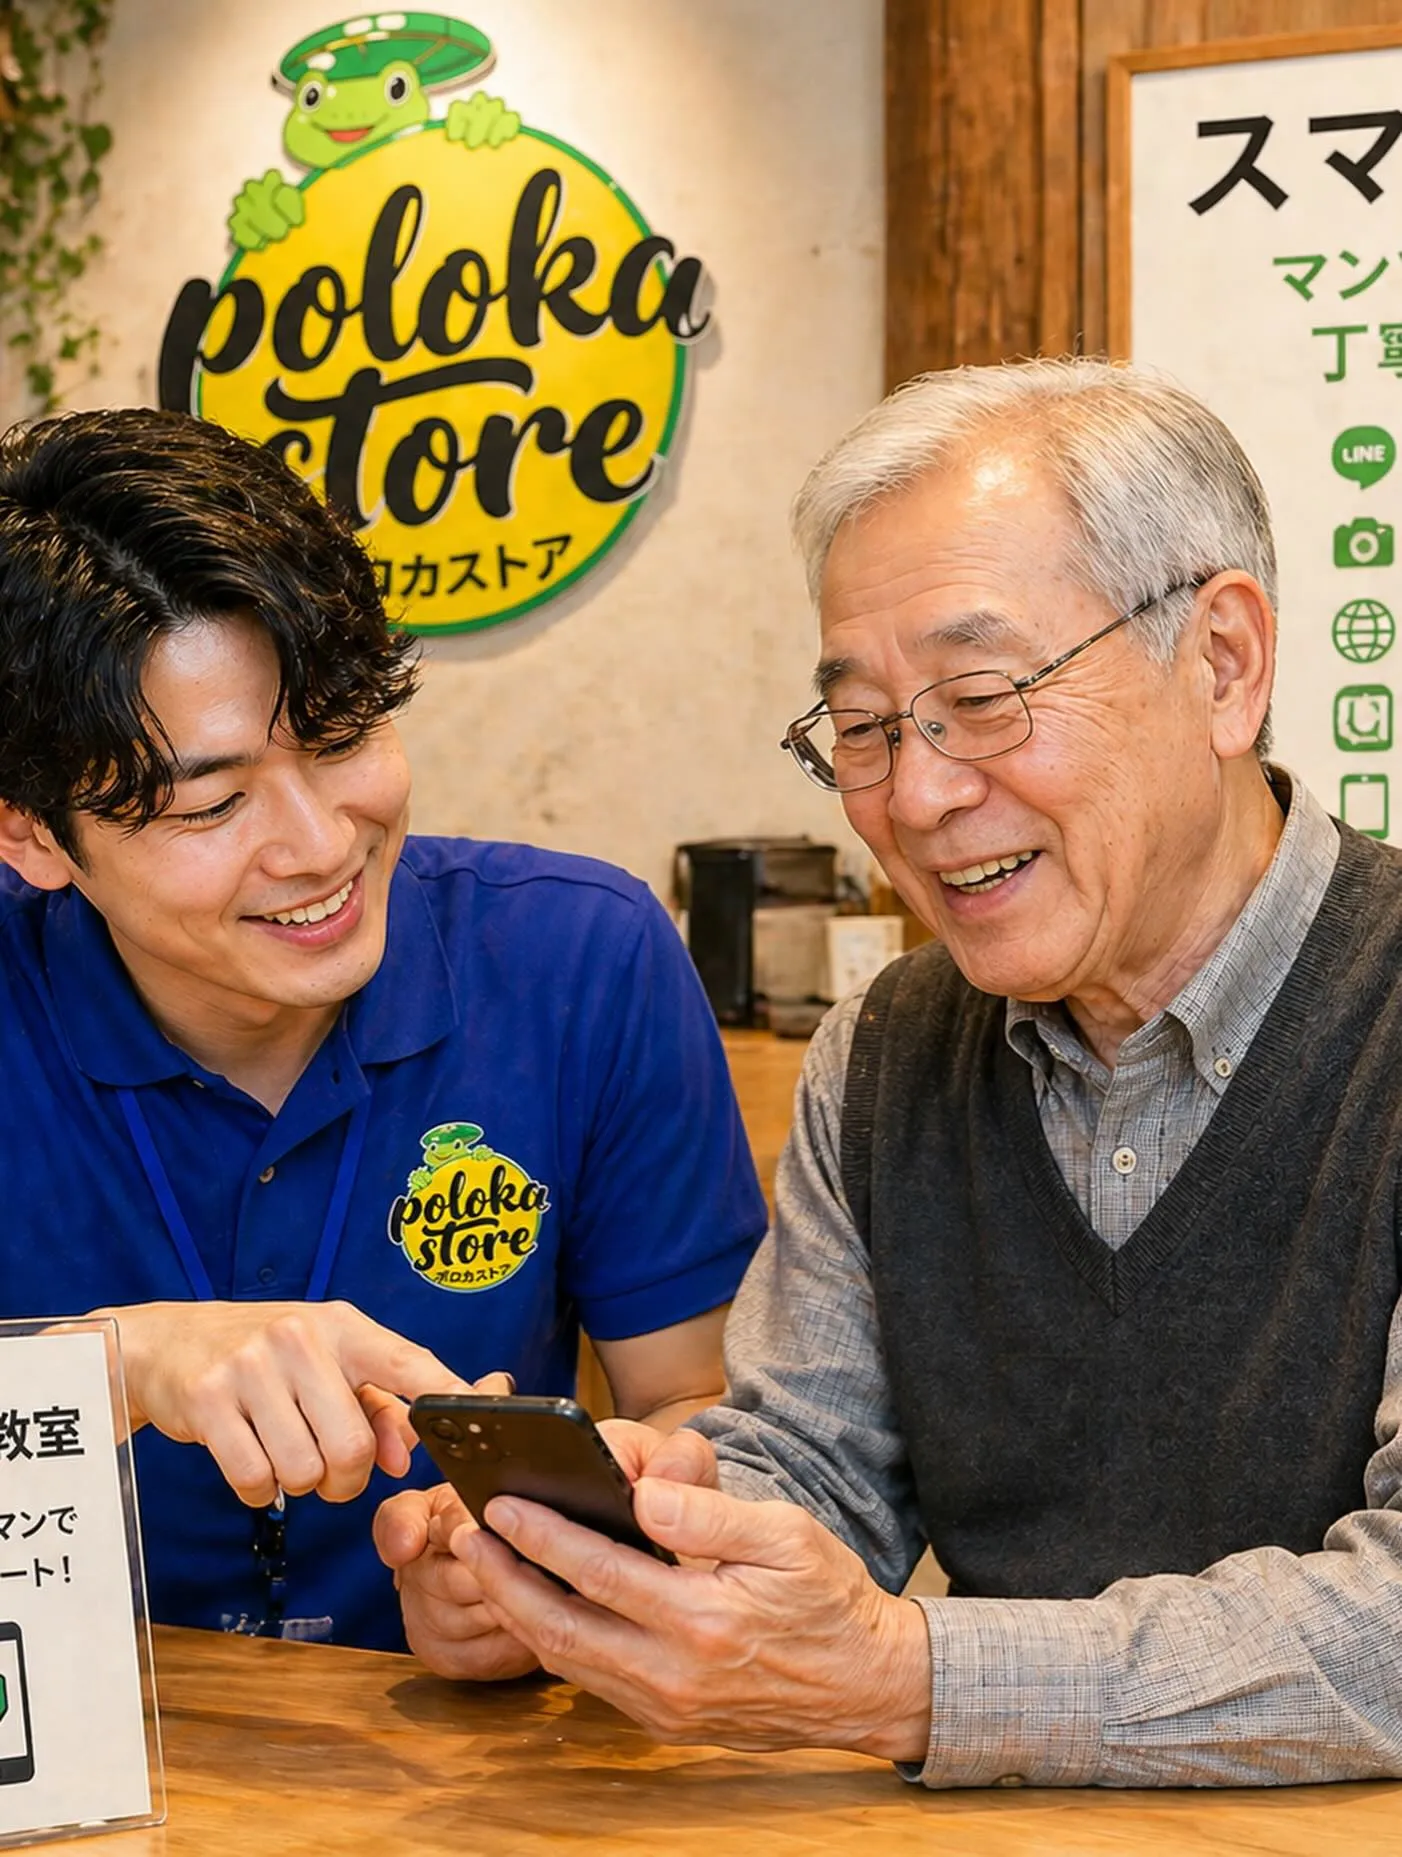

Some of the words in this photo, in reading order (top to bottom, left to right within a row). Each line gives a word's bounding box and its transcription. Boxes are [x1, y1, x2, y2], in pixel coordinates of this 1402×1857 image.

[158, 168, 711, 415] poloka
[1272, 250, 1402, 301] マン
[1342, 444, 1386, 464] LINE
[390, 1164, 549, 1243] poloka
[414, 1217, 537, 1271] store
